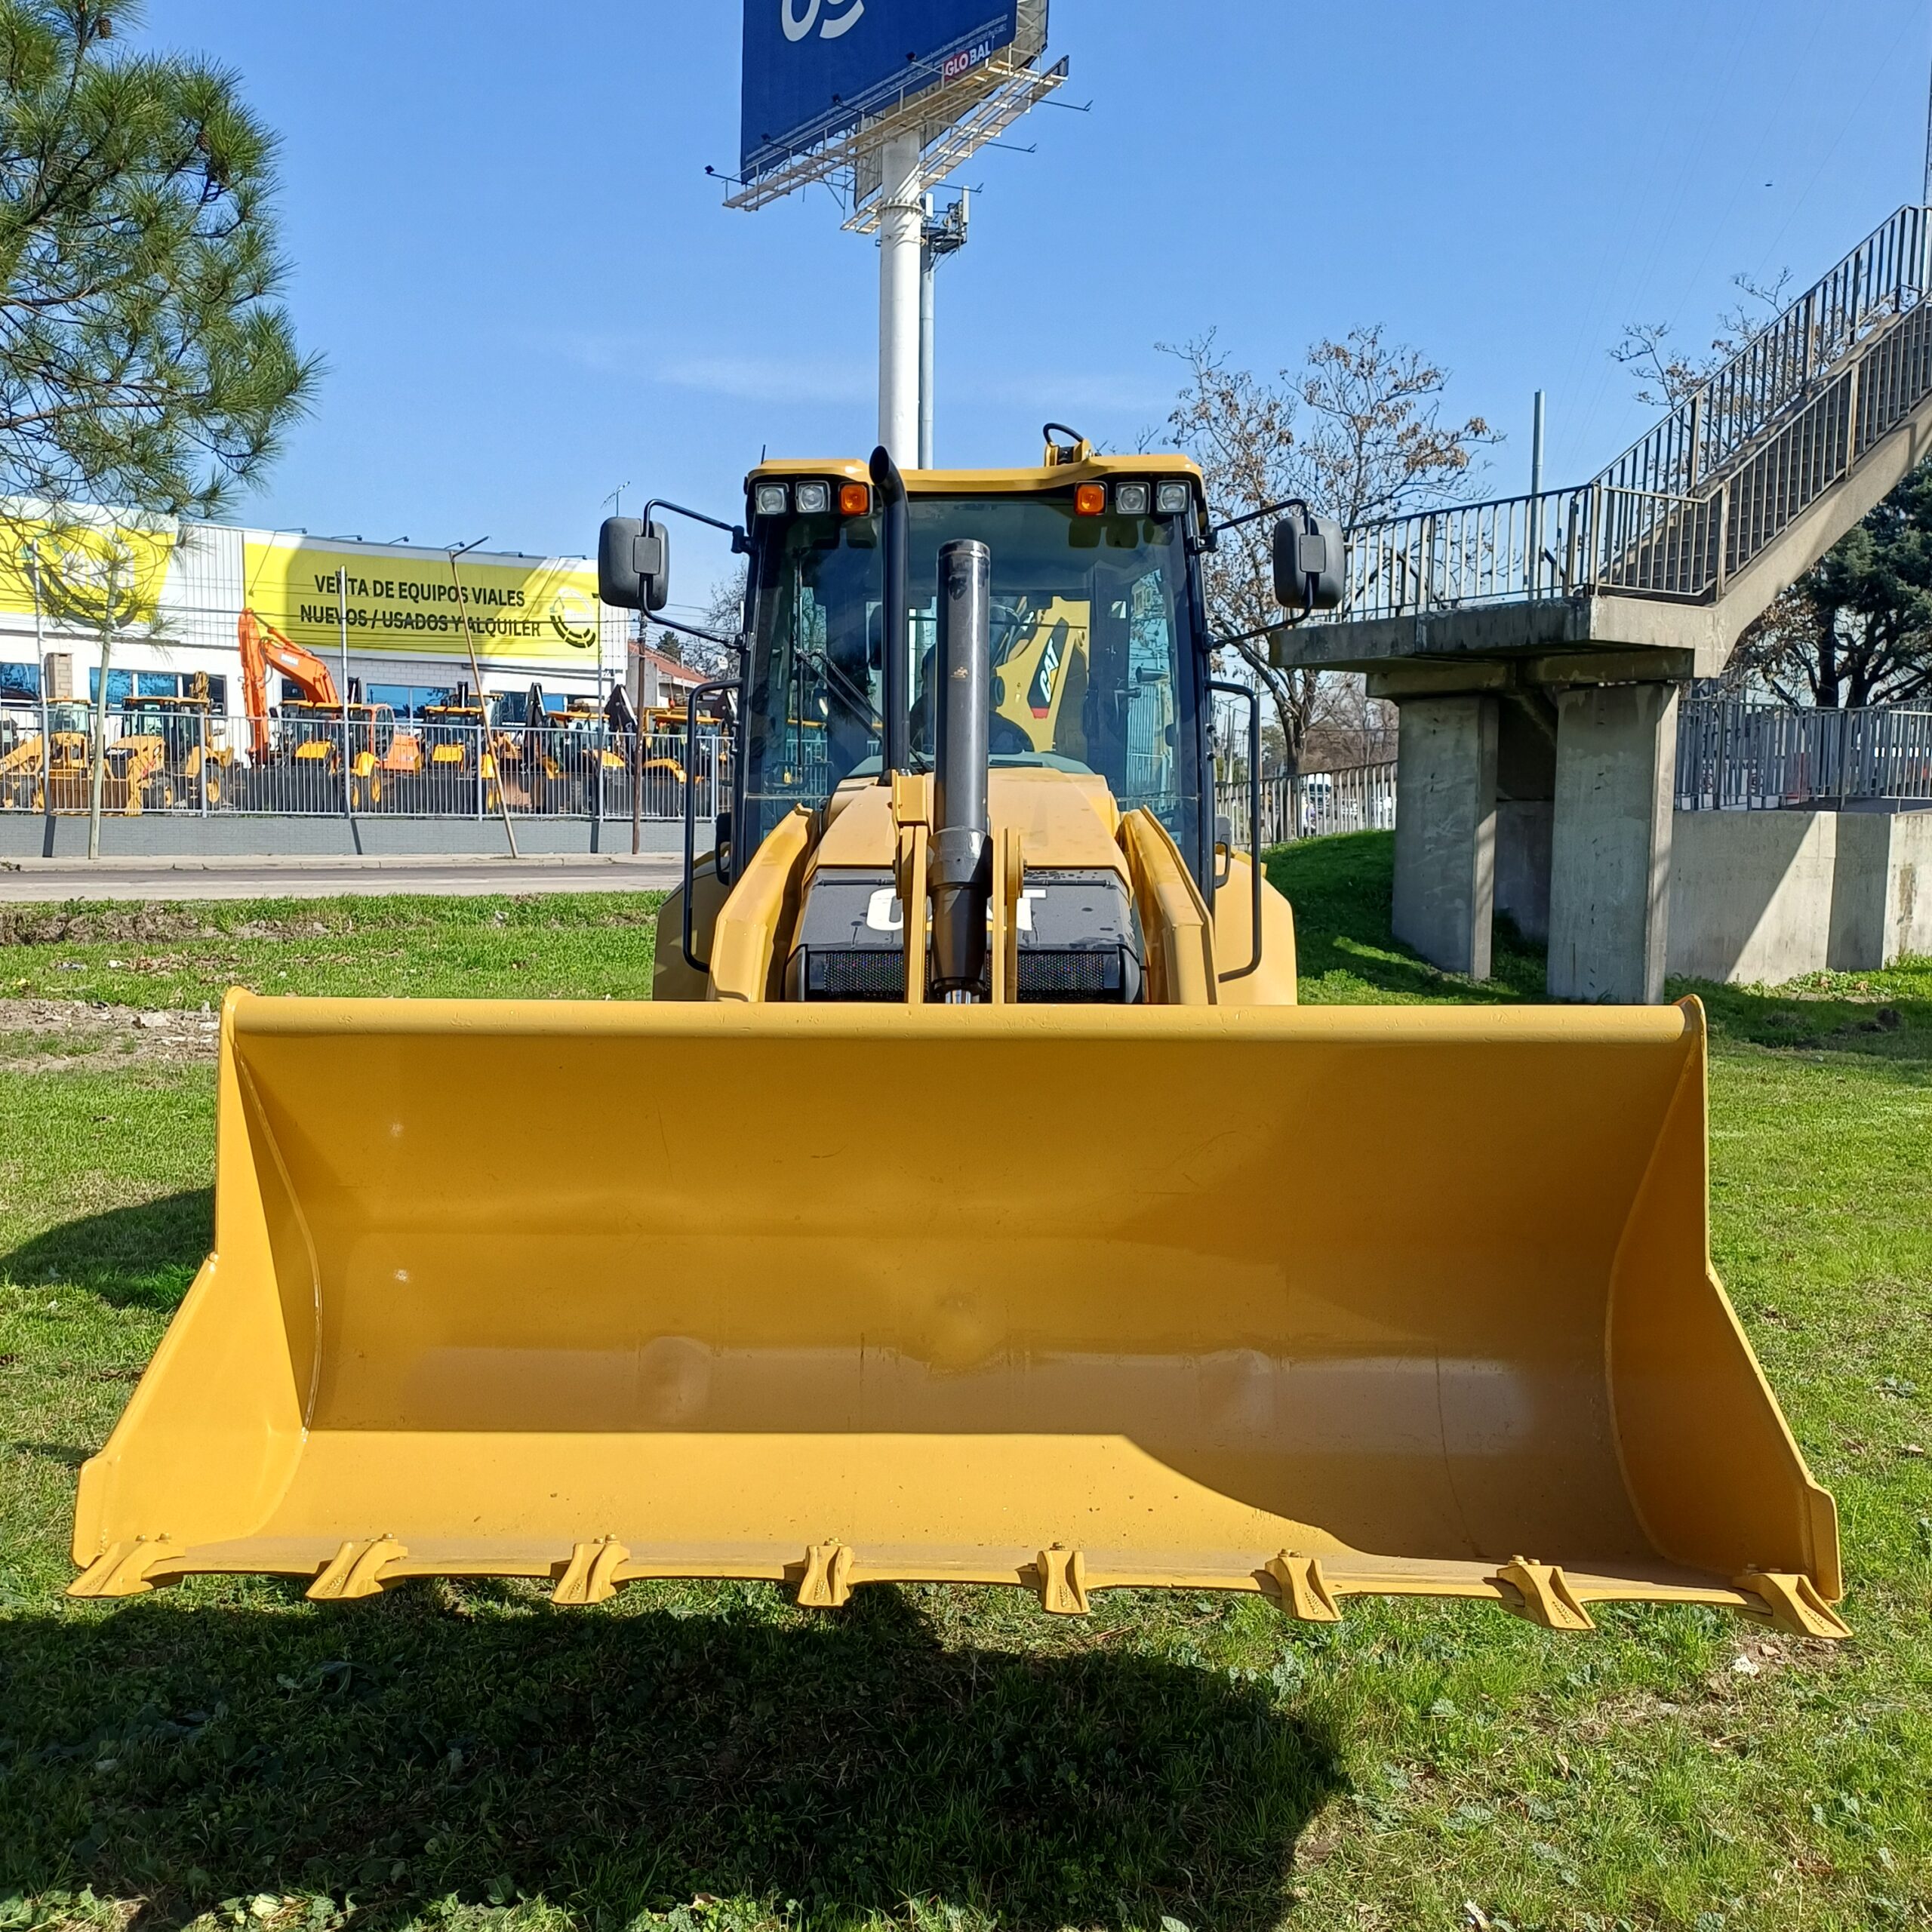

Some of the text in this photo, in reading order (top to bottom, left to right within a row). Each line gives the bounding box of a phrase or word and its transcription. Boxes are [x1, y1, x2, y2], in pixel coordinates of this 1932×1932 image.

[945, 40, 991, 76] GLOBAL
[373, 580, 395, 598] DE
[398, 582, 469, 604] EQUIPOS
[472, 587, 525, 607] VIALES
[382, 611, 448, 632] USADOS
[451, 615, 462, 632] Y
[466, 617, 541, 638] ALQUILER
[1039, 637, 1060, 703] CAT
